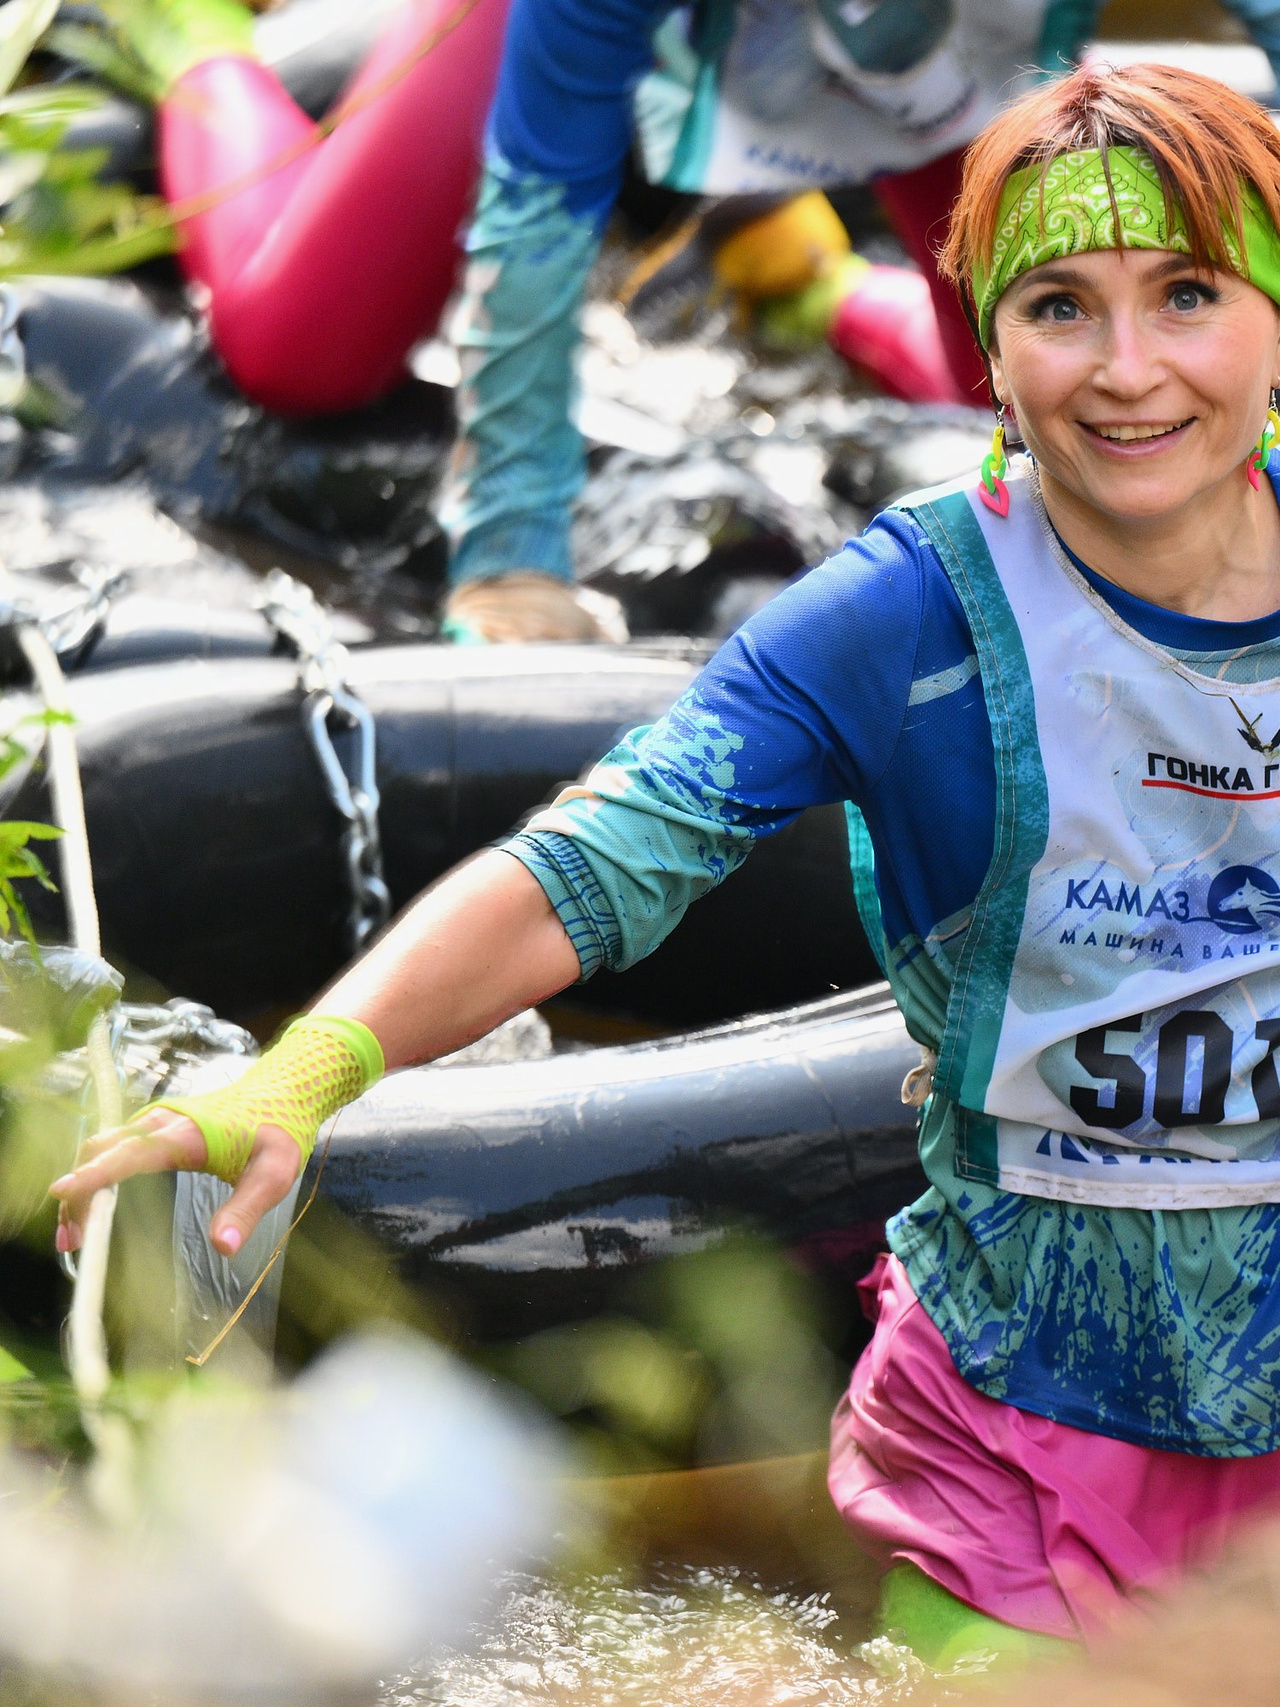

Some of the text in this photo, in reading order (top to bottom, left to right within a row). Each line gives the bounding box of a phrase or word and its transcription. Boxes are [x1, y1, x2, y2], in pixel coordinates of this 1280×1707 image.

[1147, 752, 1254, 791] ГОНКА
[1065, 878, 1190, 922] КАМАЗ
[1059, 929, 1184, 958] МАШИНА
